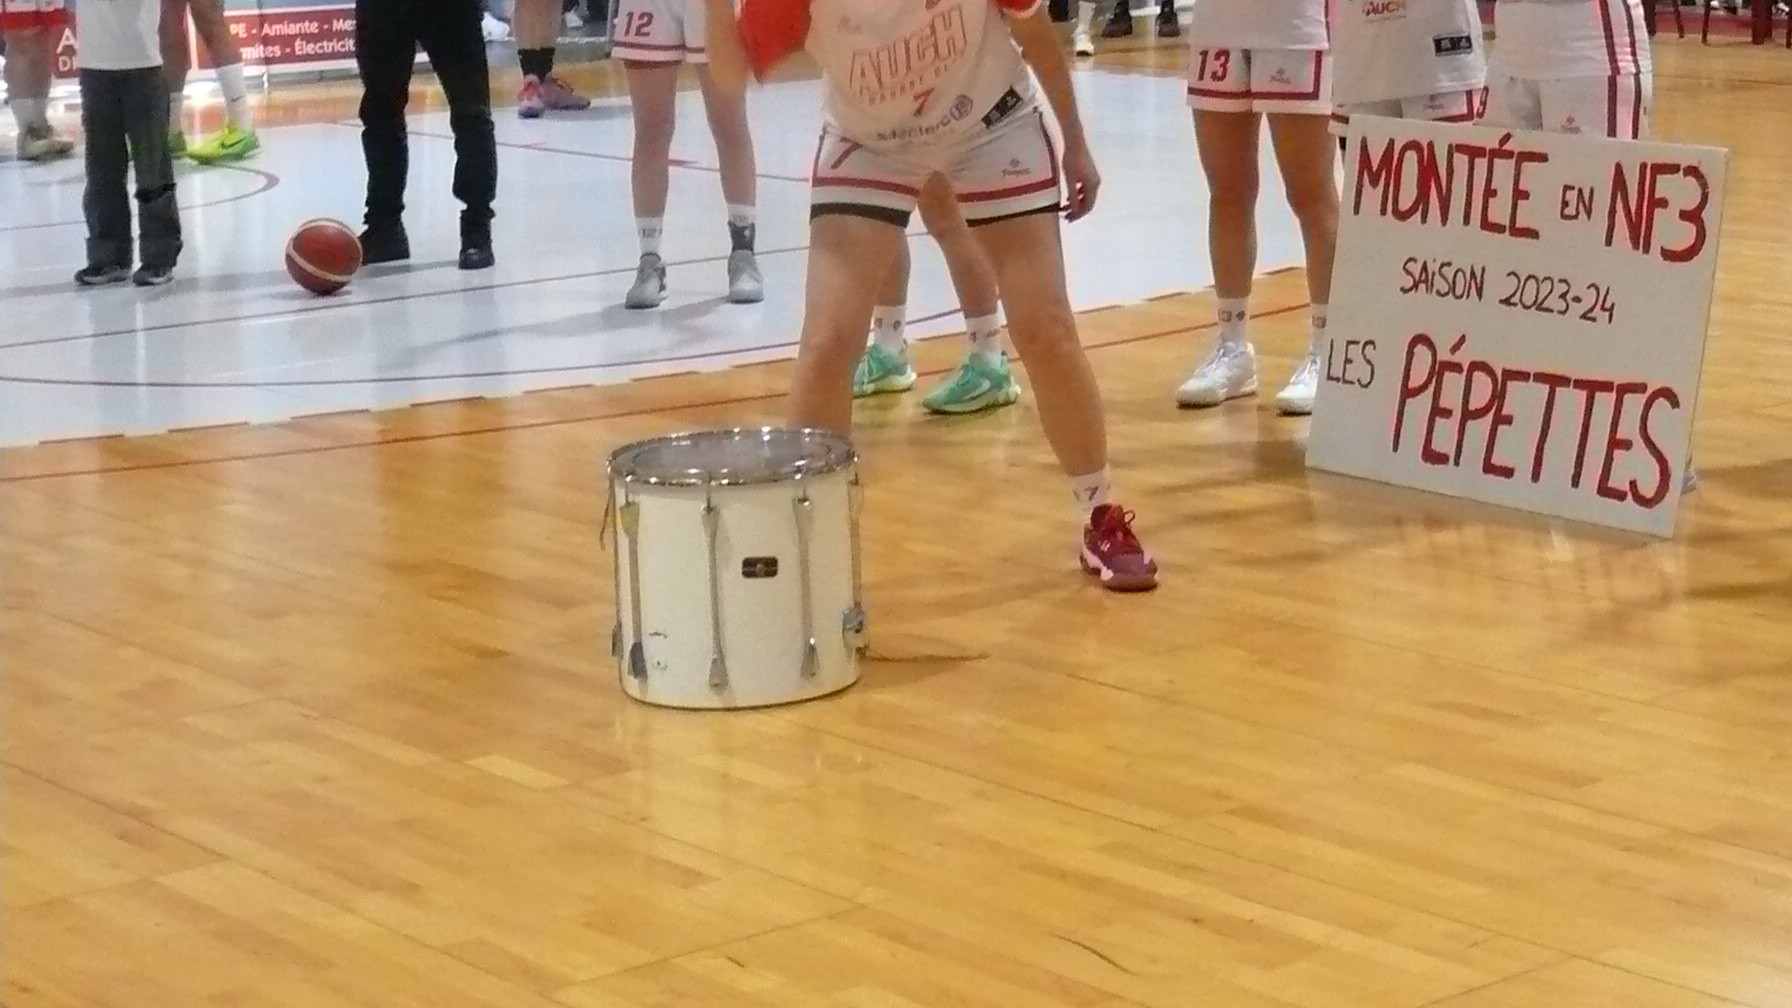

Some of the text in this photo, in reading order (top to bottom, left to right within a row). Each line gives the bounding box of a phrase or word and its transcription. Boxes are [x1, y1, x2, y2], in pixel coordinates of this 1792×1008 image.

[229, 22, 247, 39] PE
[260, 18, 319, 37] Amiante
[623, 11, 654, 37] 12
[239, 43, 282, 59] mites
[294, 37, 357, 55] Électricit
[849, 3, 968, 92] AUCH
[1198, 47, 1231, 82] 13
[912, 87, 935, 118] 7
[830, 136, 863, 170] 7
[1353, 132, 1709, 263] MONTÉE EN NF3
[1499, 271, 1617, 325] 2023-24
[1325, 333, 1681, 509] LES PÉPETTES
